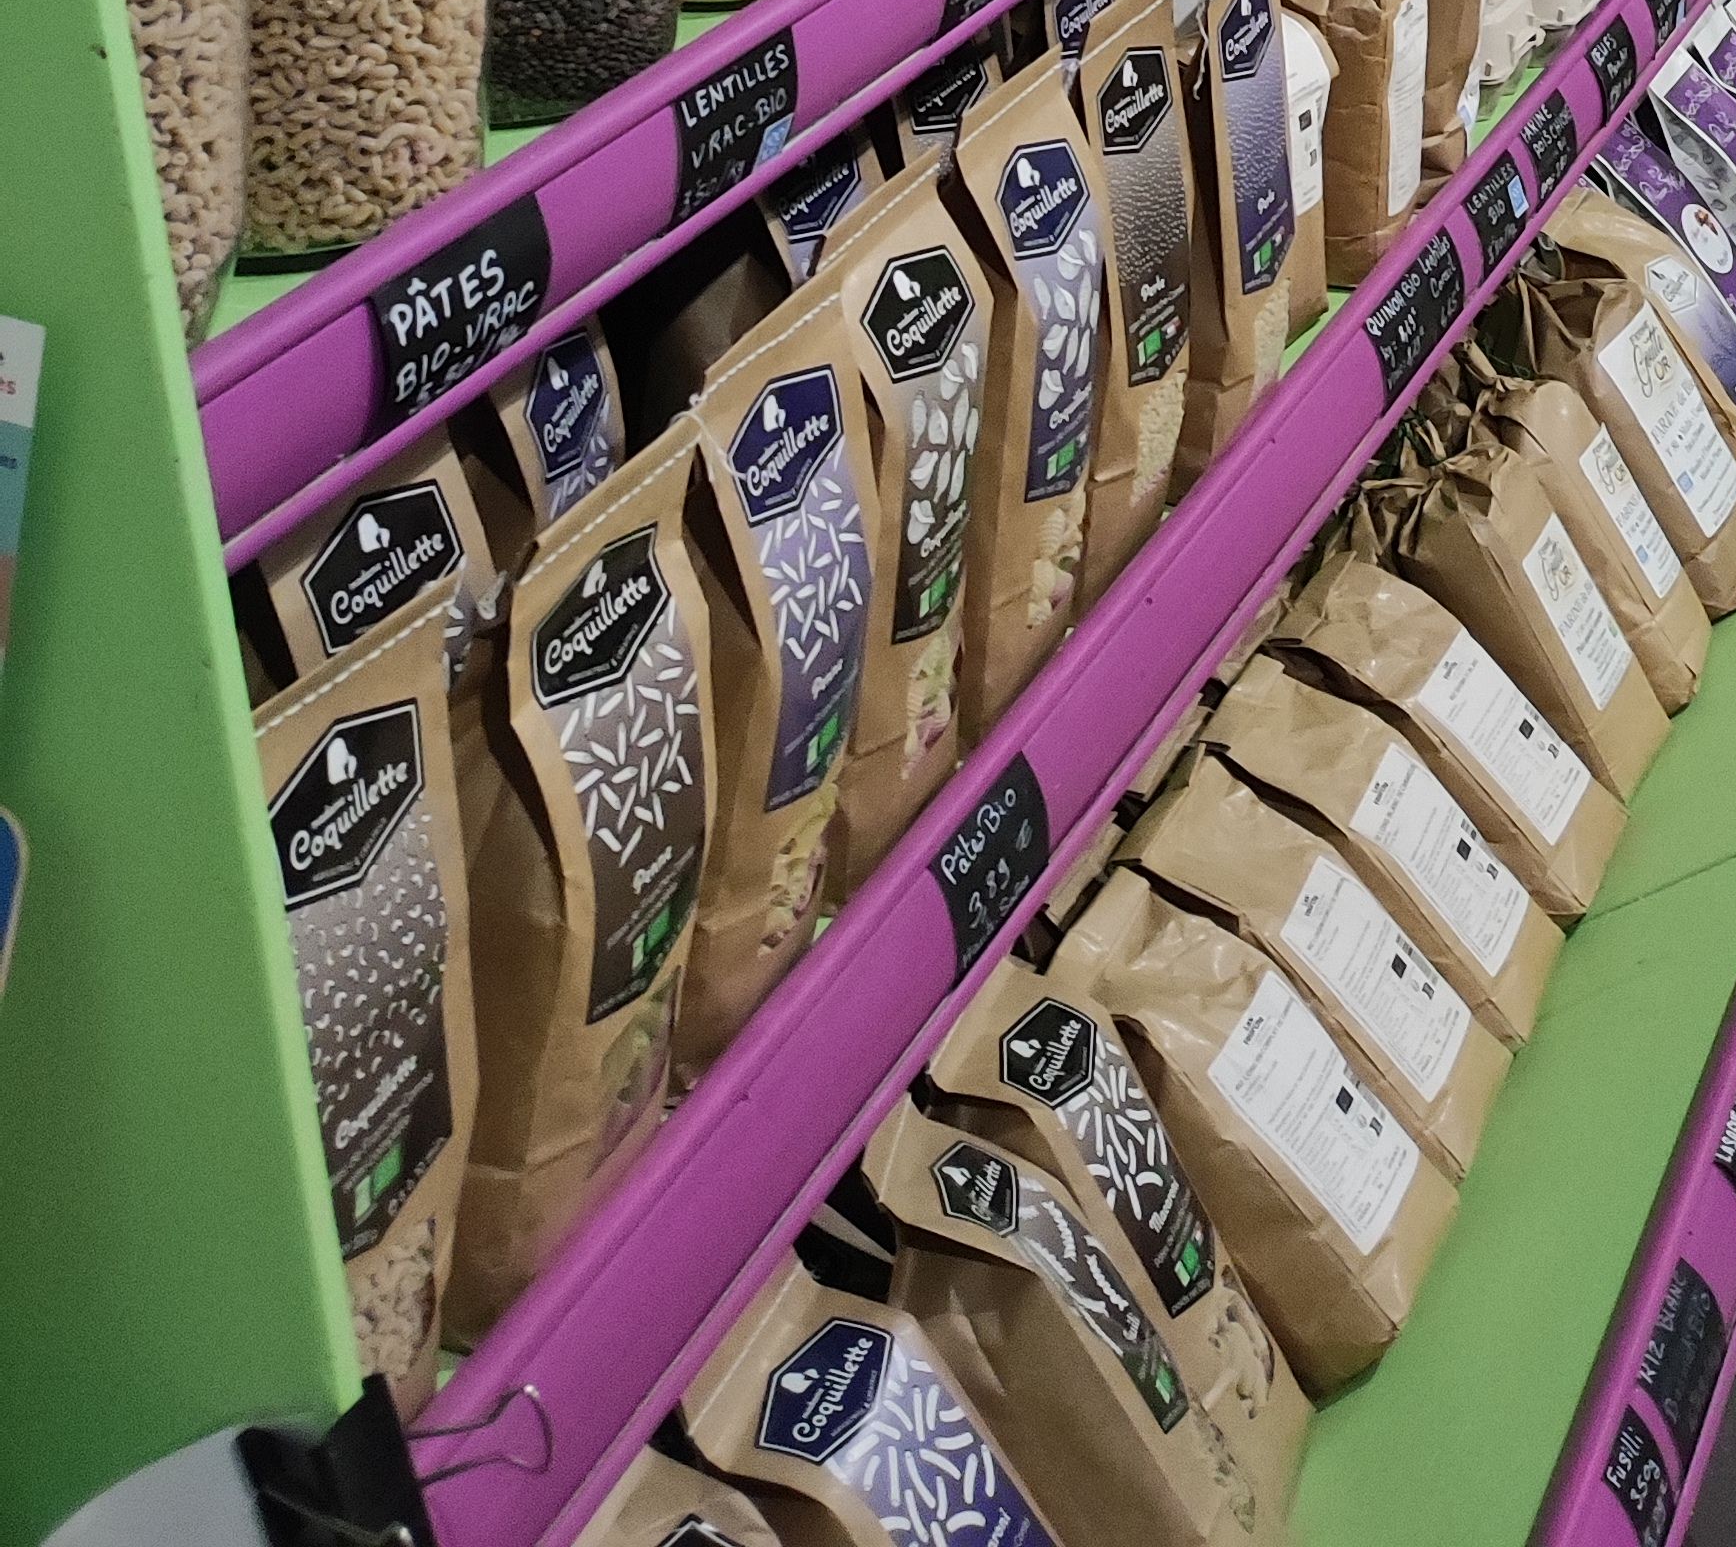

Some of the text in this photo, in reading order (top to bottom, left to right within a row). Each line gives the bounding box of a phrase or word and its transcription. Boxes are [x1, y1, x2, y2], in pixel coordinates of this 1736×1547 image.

[1104, 82, 1166, 136] Coquillette
[779, 161, 850, 223] Coquillette
[1007, 175, 1080, 241] Coquillette
[389, 248, 506, 349] PÂTES
[884, 283, 963, 358] Coquillette
[543, 372, 600, 454] Coquillette
[746, 413, 830, 498] Coquillette
[329, 531, 446, 626] Coquillette
[544, 574, 652, 676] Coquillette
[289, 755, 409, 871] Coquillette
[976, 787, 1017, 834] Bio
[1027, 1018, 1083, 1094] Coquillette
[792, 1336, 874, 1445] Coquillette
